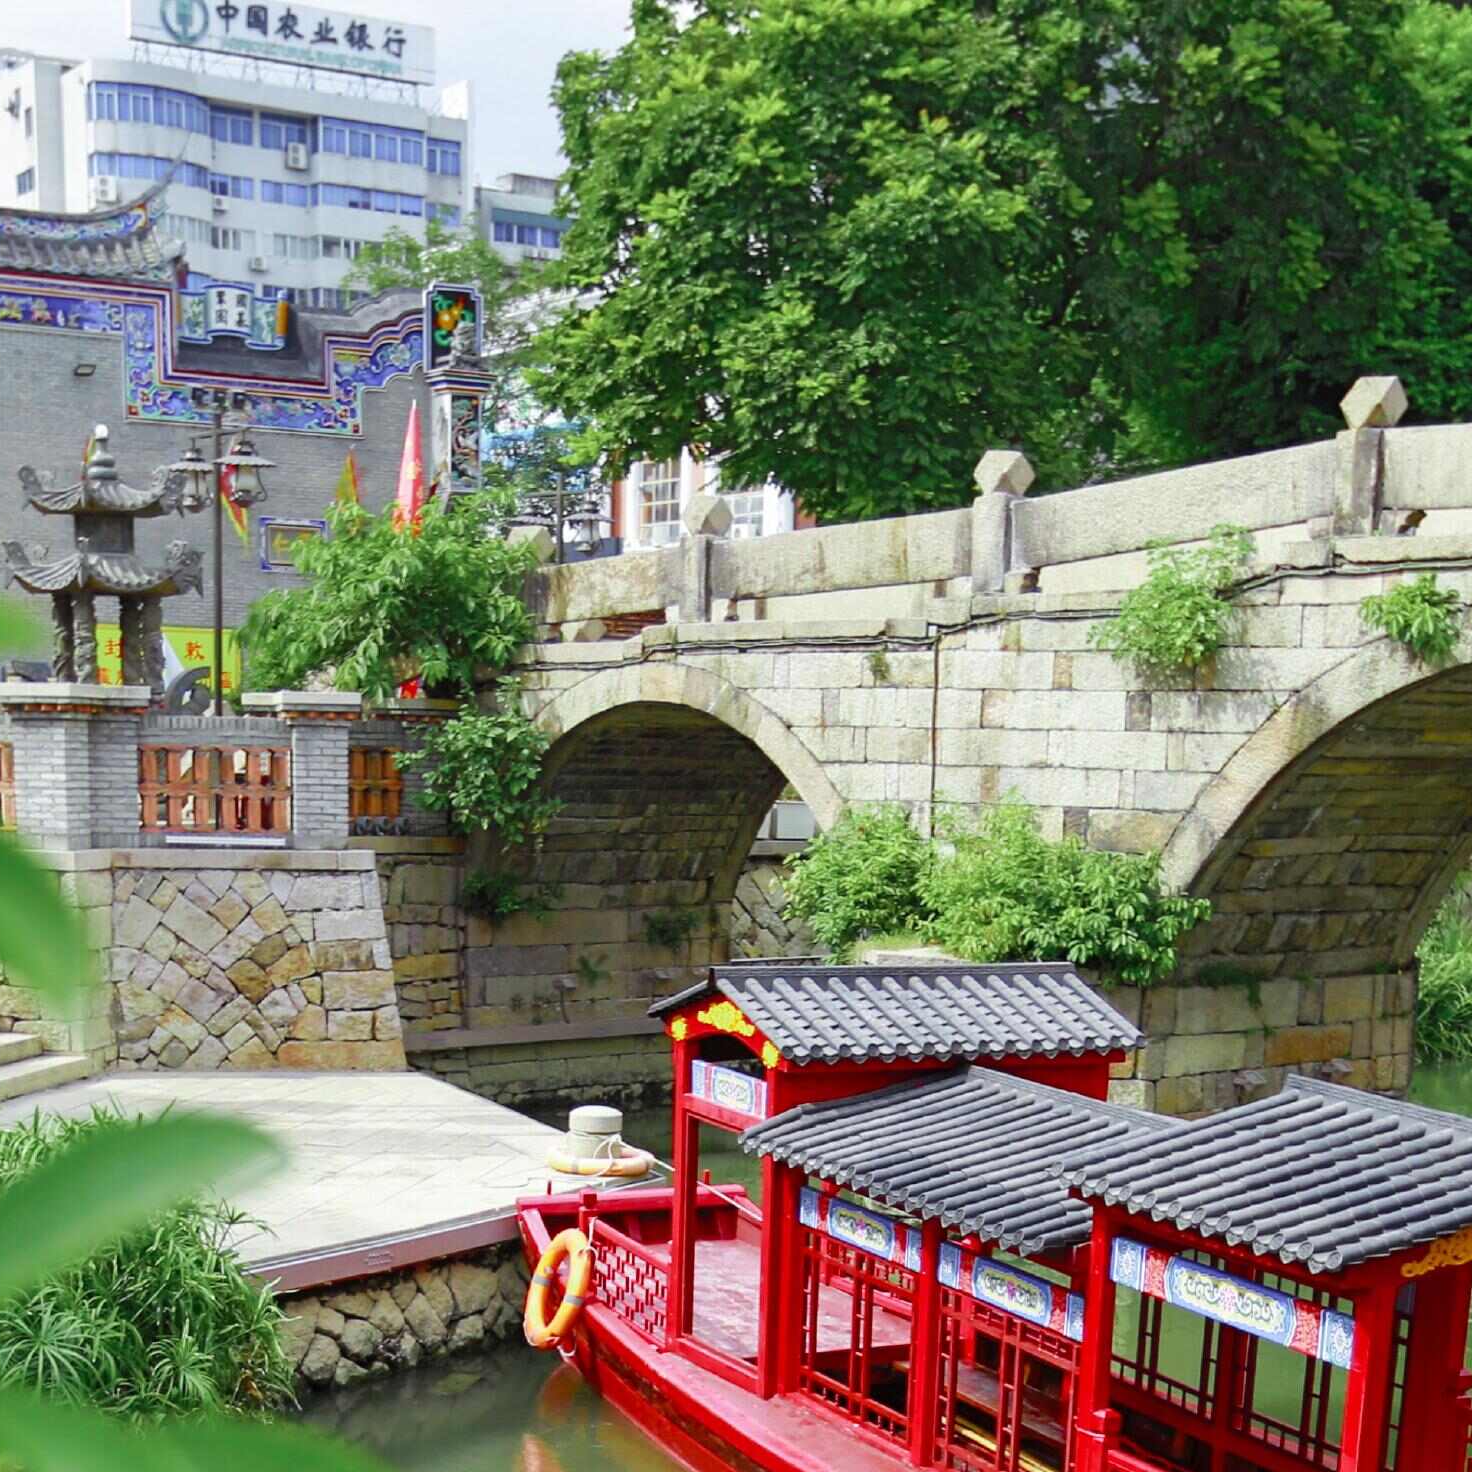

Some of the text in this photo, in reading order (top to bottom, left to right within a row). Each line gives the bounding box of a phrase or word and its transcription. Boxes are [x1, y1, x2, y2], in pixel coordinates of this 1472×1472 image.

[215, 0, 408, 58] 中国农业银行
